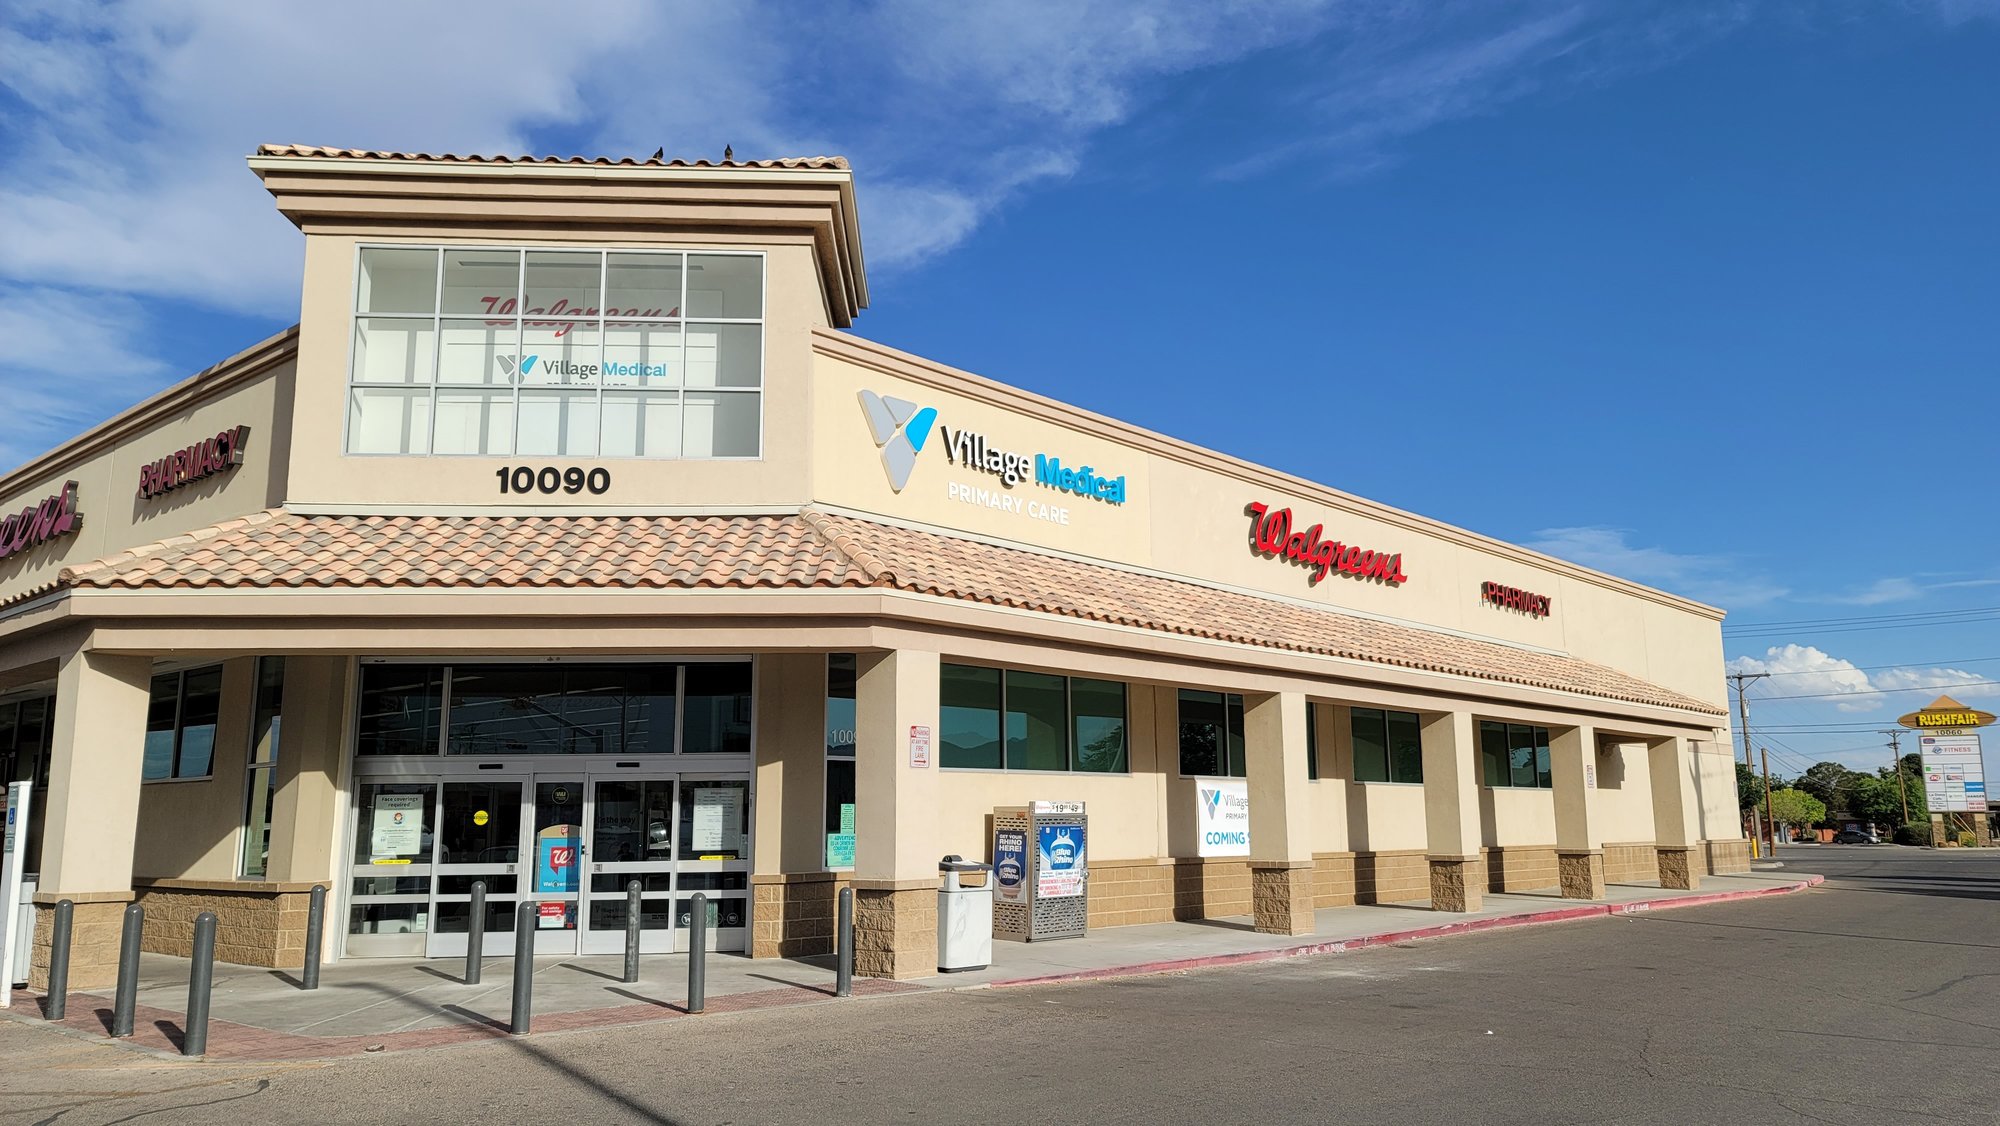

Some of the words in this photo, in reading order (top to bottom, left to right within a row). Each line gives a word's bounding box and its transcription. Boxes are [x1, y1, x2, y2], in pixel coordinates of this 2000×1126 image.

[481, 295, 681, 337] Walgreens
[543, 360, 598, 380] Village
[603, 361, 667, 377] Medical
[139, 425, 250, 499] PHARMACY
[941, 425, 1031, 486] Village
[1035, 453, 1125, 504] Medical
[496, 466, 611, 494] 10090
[948, 481, 1023, 514] PRIMARY
[1027, 501, 1070, 526] CARE
[1245, 501, 1407, 583] Walgreens
[1482, 581, 1551, 617] PHARMACY
[1917, 713, 1979, 726] RUSHFAIR
[998, 844, 1022, 852] HERE!
[999, 838, 1022, 846] RHINO
[1056, 848, 1071, 856] Blue
[1206, 832, 1246, 845] COMING
